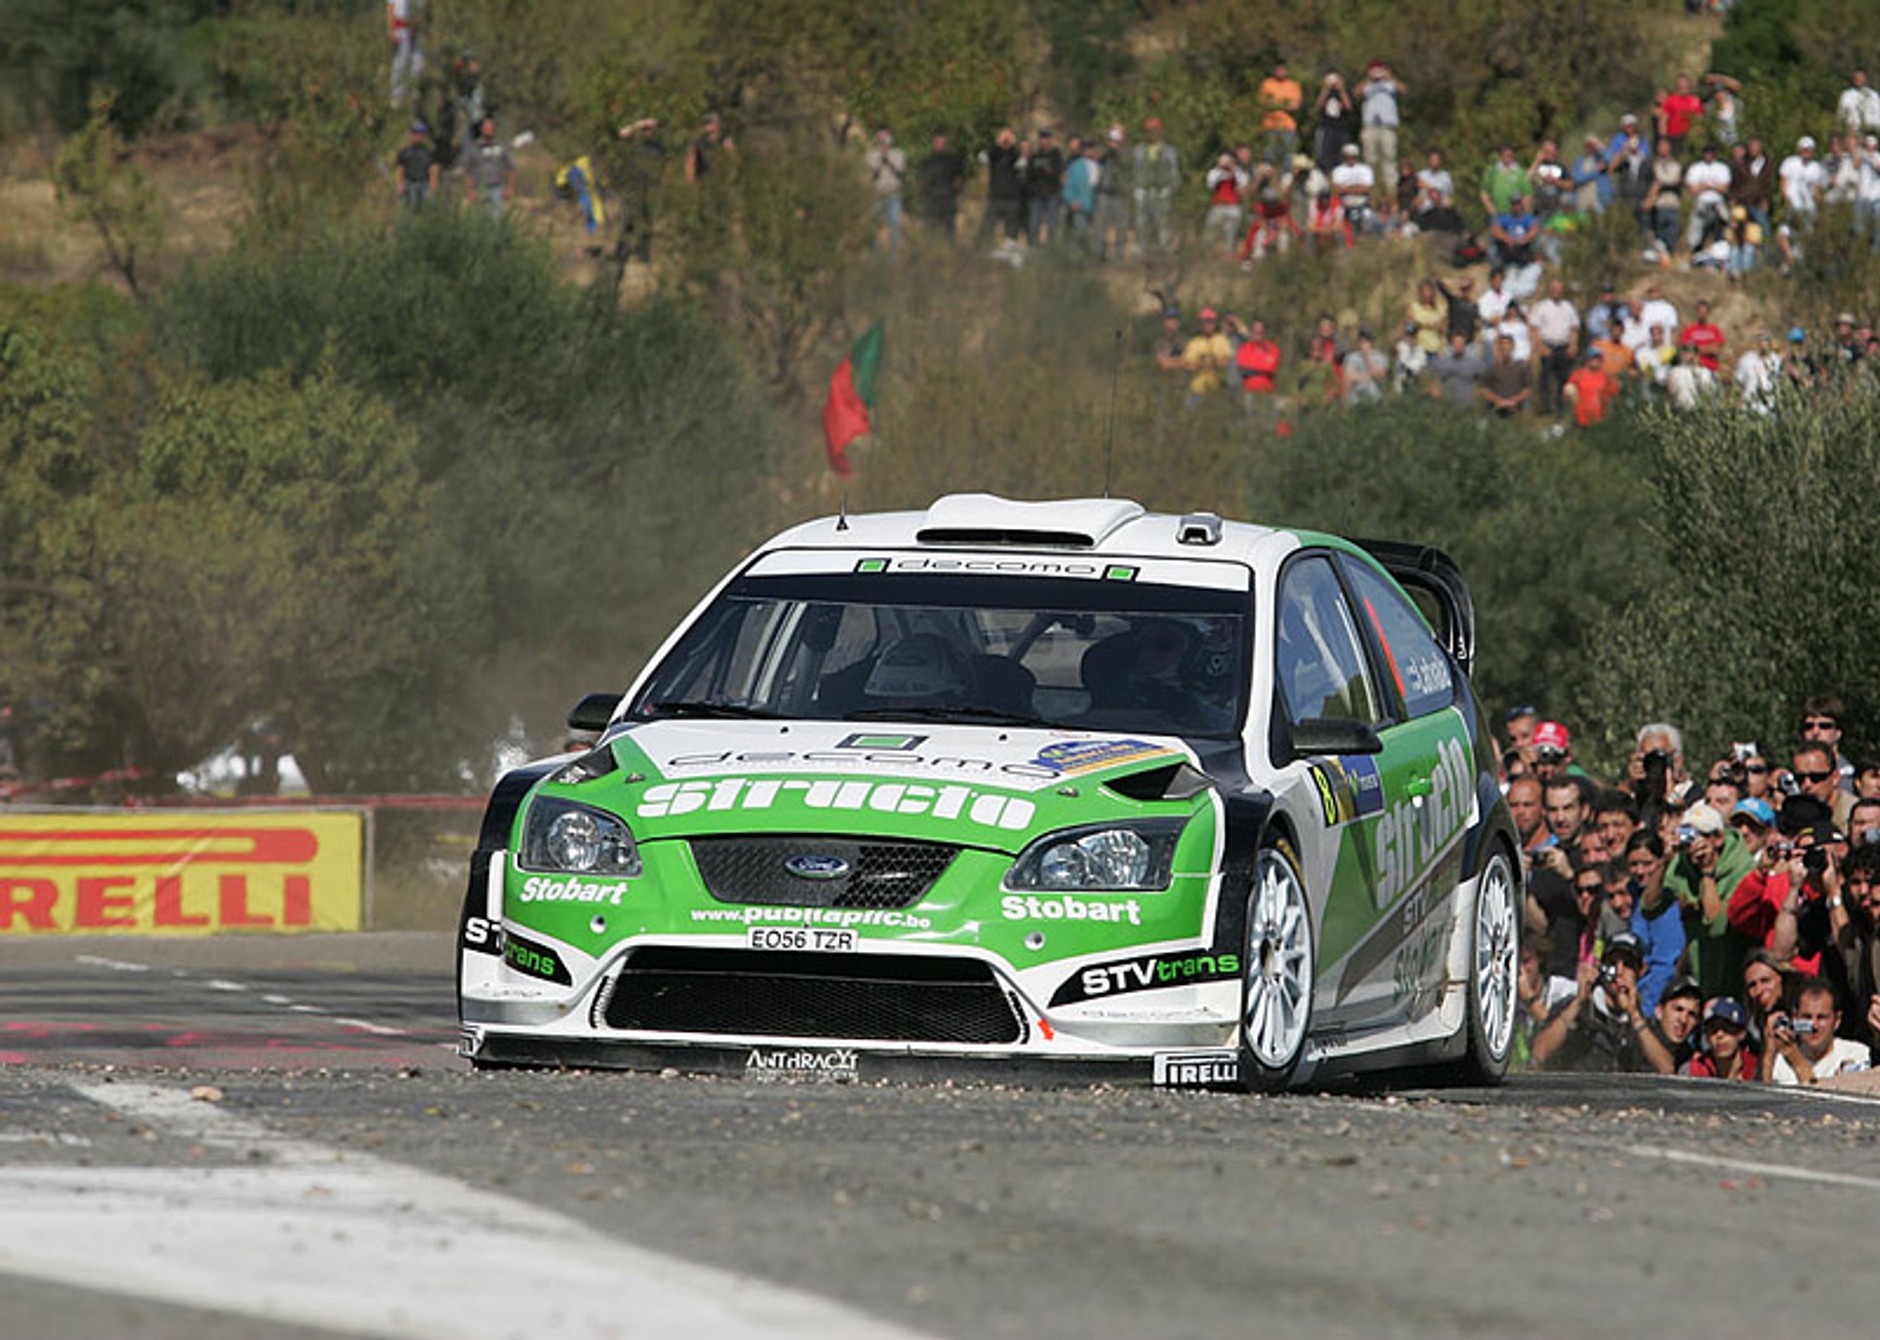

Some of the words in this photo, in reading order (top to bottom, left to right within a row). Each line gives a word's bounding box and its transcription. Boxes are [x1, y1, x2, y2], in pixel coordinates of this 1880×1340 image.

[897, 558, 1096, 575] decomo
[667, 750, 1061, 779] decomo
[520, 877, 628, 904] Stobart
[1001, 896, 1141, 925] Stobart
[752, 930, 806, 949] EO56
[813, 931, 853, 950] TZR
[1153, 1050, 1238, 1085] PIRELLI
